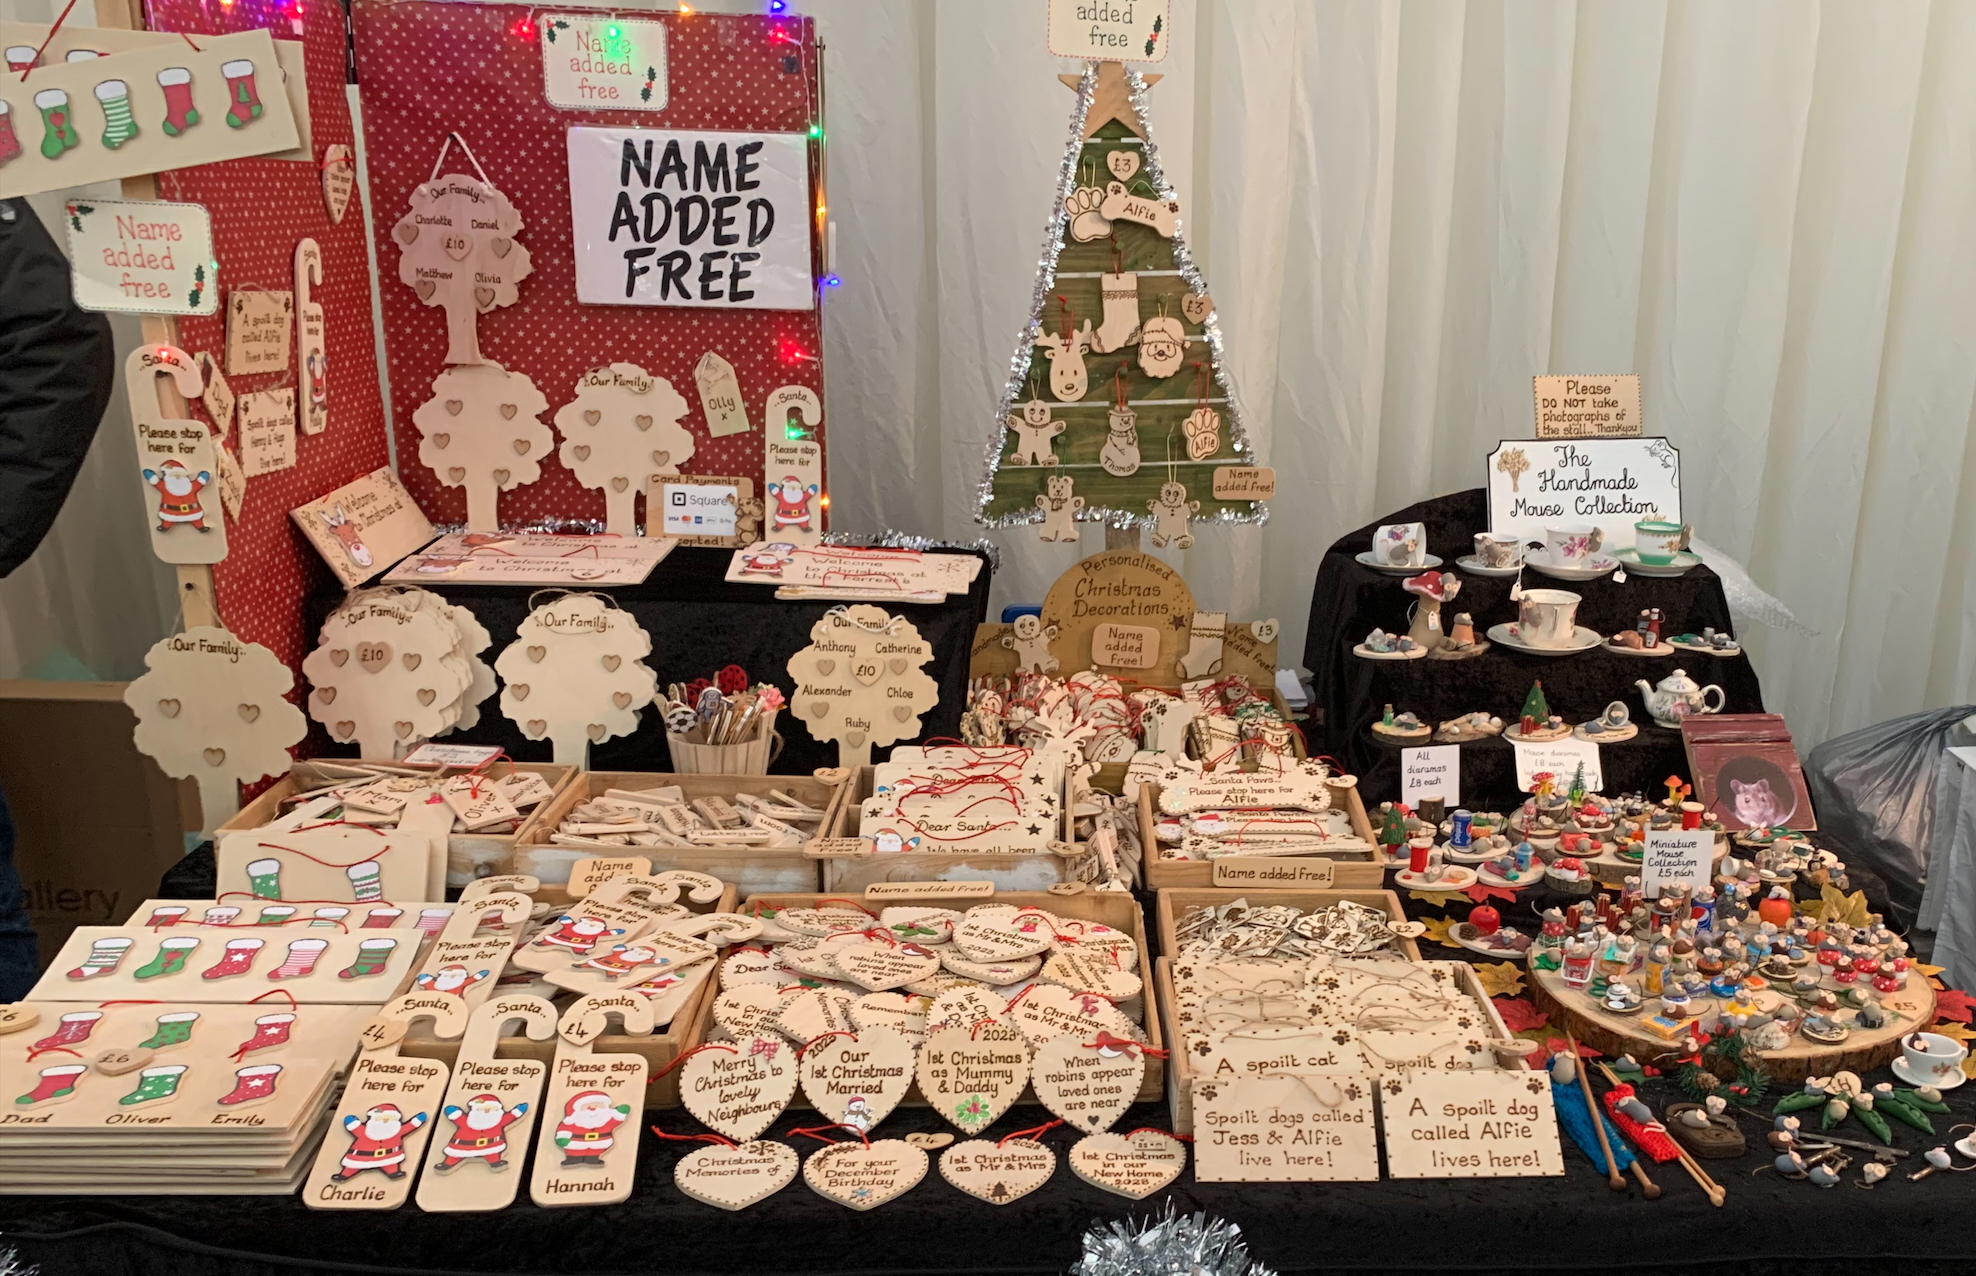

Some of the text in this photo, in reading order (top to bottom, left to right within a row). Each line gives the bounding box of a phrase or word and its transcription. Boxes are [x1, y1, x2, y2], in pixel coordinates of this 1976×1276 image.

[1077, 5, 1133, 25] added
[576, 31, 631, 55] Name
[1089, 26, 1128, 46] free
[569, 55, 632, 76] added
[578, 80, 619, 100] free
[620, 138, 764, 192] NAME
[1113, 158, 1130, 172] £3
[1122, 202, 1156, 221] Alfie
[415, 214, 452, 226] Charlotte
[471, 220, 499, 230] Daniel
[609, 192, 774, 247] ADDED
[116, 216, 182, 241] Name
[446, 239, 465, 249] £10
[103, 246, 175, 270] added
[416, 268, 453, 279] Matthew
[475, 273, 501, 283] Olivia
[624, 248, 760, 301] FREE
[120, 273, 171, 299] free
[1186, 300, 1204, 314] £3
[1566, 380, 1611, 395] Please
[709, 397, 736, 411] Olly
[1542, 398, 1618, 408] DO NOT take
[1543, 409, 1626, 426] photographs of
[139, 425, 203, 443] Please stop
[1543, 423, 1559, 435] the
[147, 441, 172, 454] here
[1195, 437, 1216, 452] Alfie
[1554, 444, 1592, 468] The
[1104, 456, 1136, 472] Thomas
[651, 475, 739, 485] Card Payments
[1229, 470, 1258, 478] Name
[1538, 468, 1638, 492] Handmade
[1215, 480, 1248, 492] added
[690, 495, 728, 506] Square
[1510, 494, 1658, 517] Mouse Collection
[1081, 553, 1173, 582] Personalised
[1074, 578, 1161, 598] Christmas
[1072, 599, 1169, 618] Decorations
[1108, 627, 1143, 640] Name
[1257, 625, 1273, 637] £3
[813, 640, 856, 658] Anthony
[875, 643, 922, 654] Catherine
[1105, 642, 1142, 652] added
[361, 650, 383, 662] £10
[856, 665, 875, 676] £10
[802, 685, 852, 696] Alexander
[887, 687, 913, 698] Chloe
[846, 718, 870, 732] Ruby
[1416, 751, 1430, 760] All
[1407, 765, 1447, 774] diaramas
[1409, 779, 1422, 788] £8
[1227, 787, 1247, 796] stop
[1222, 795, 1258, 803] Alfie
[1650, 839, 1697, 849] Miniature
[1657, 850, 1684, 858] Mouse
[591, 860, 633, 871] Name
[1648, 858, 1697, 868] Collection
[1218, 866, 1255, 878] Name
[1260, 868, 1296, 880] added
[1658, 868, 1694, 878] £5 each
[363, 1023, 384, 1041] £4
[565, 1023, 587, 1038] £4
[983, 1030, 1017, 1041] 2023
[99, 1054, 129, 1063] £6
[840, 1051, 870, 1063] Our
[951, 1052, 1022, 1065] Christmas
[1064, 1056, 1100, 1067] When
[1216, 1052, 1338, 1074] A spoilt cat
[357, 1059, 438, 1077] Please stop
[558, 1059, 641, 1074] Please stop
[713, 1057, 756, 1074] Merry
[832, 1065, 904, 1079] Christmas
[566, 1076, 597, 1088] here
[695, 1064, 783, 1093] Christmas to
[931, 1067, 1013, 1084] as Mummy
[1045, 1067, 1135, 1084] robins appear
[362, 1078, 396, 1091] here
[826, 1080, 882, 1094] Married
[938, 1080, 998, 1098] & Daddy
[1058, 1085, 1122, 1097] loved ones
[719, 1086, 761, 1104] lovely
[708, 1100, 781, 1124] Neighbours
[1065, 1100, 1120, 1110] are near
[1409, 1098, 1538, 1120] A spoilt dog
[1, 1114, 53, 1124] Dad
[105, 1115, 172, 1124] Oliver
[211, 1115, 266, 1126] Emily
[1205, 1110, 1364, 1128] Spoilt dogs called
[1212, 1130, 1342, 1146] Jess & Alfie
[1411, 1122, 1532, 1141] called Alfie
[697, 1157, 775, 1167] Christmas
[836, 1159, 897, 1170] For your
[1239, 1151, 1333, 1167] live here!
[1432, 1150, 1540, 1167] lives here!
[686, 1166, 781, 1177] Memories of
[825, 1169, 900, 1178] December
[980, 1163, 1000, 1171] Mr
[1005, 1163, 1015, 1171] &
[1019, 1162, 1046, 1170] Mrs
[1093, 1170, 1163, 1178] New Home
[546, 1179, 614, 1194] Hannah
[828, 1178, 894, 1188] Birthday
[320, 1185, 386, 1201] Charlie
